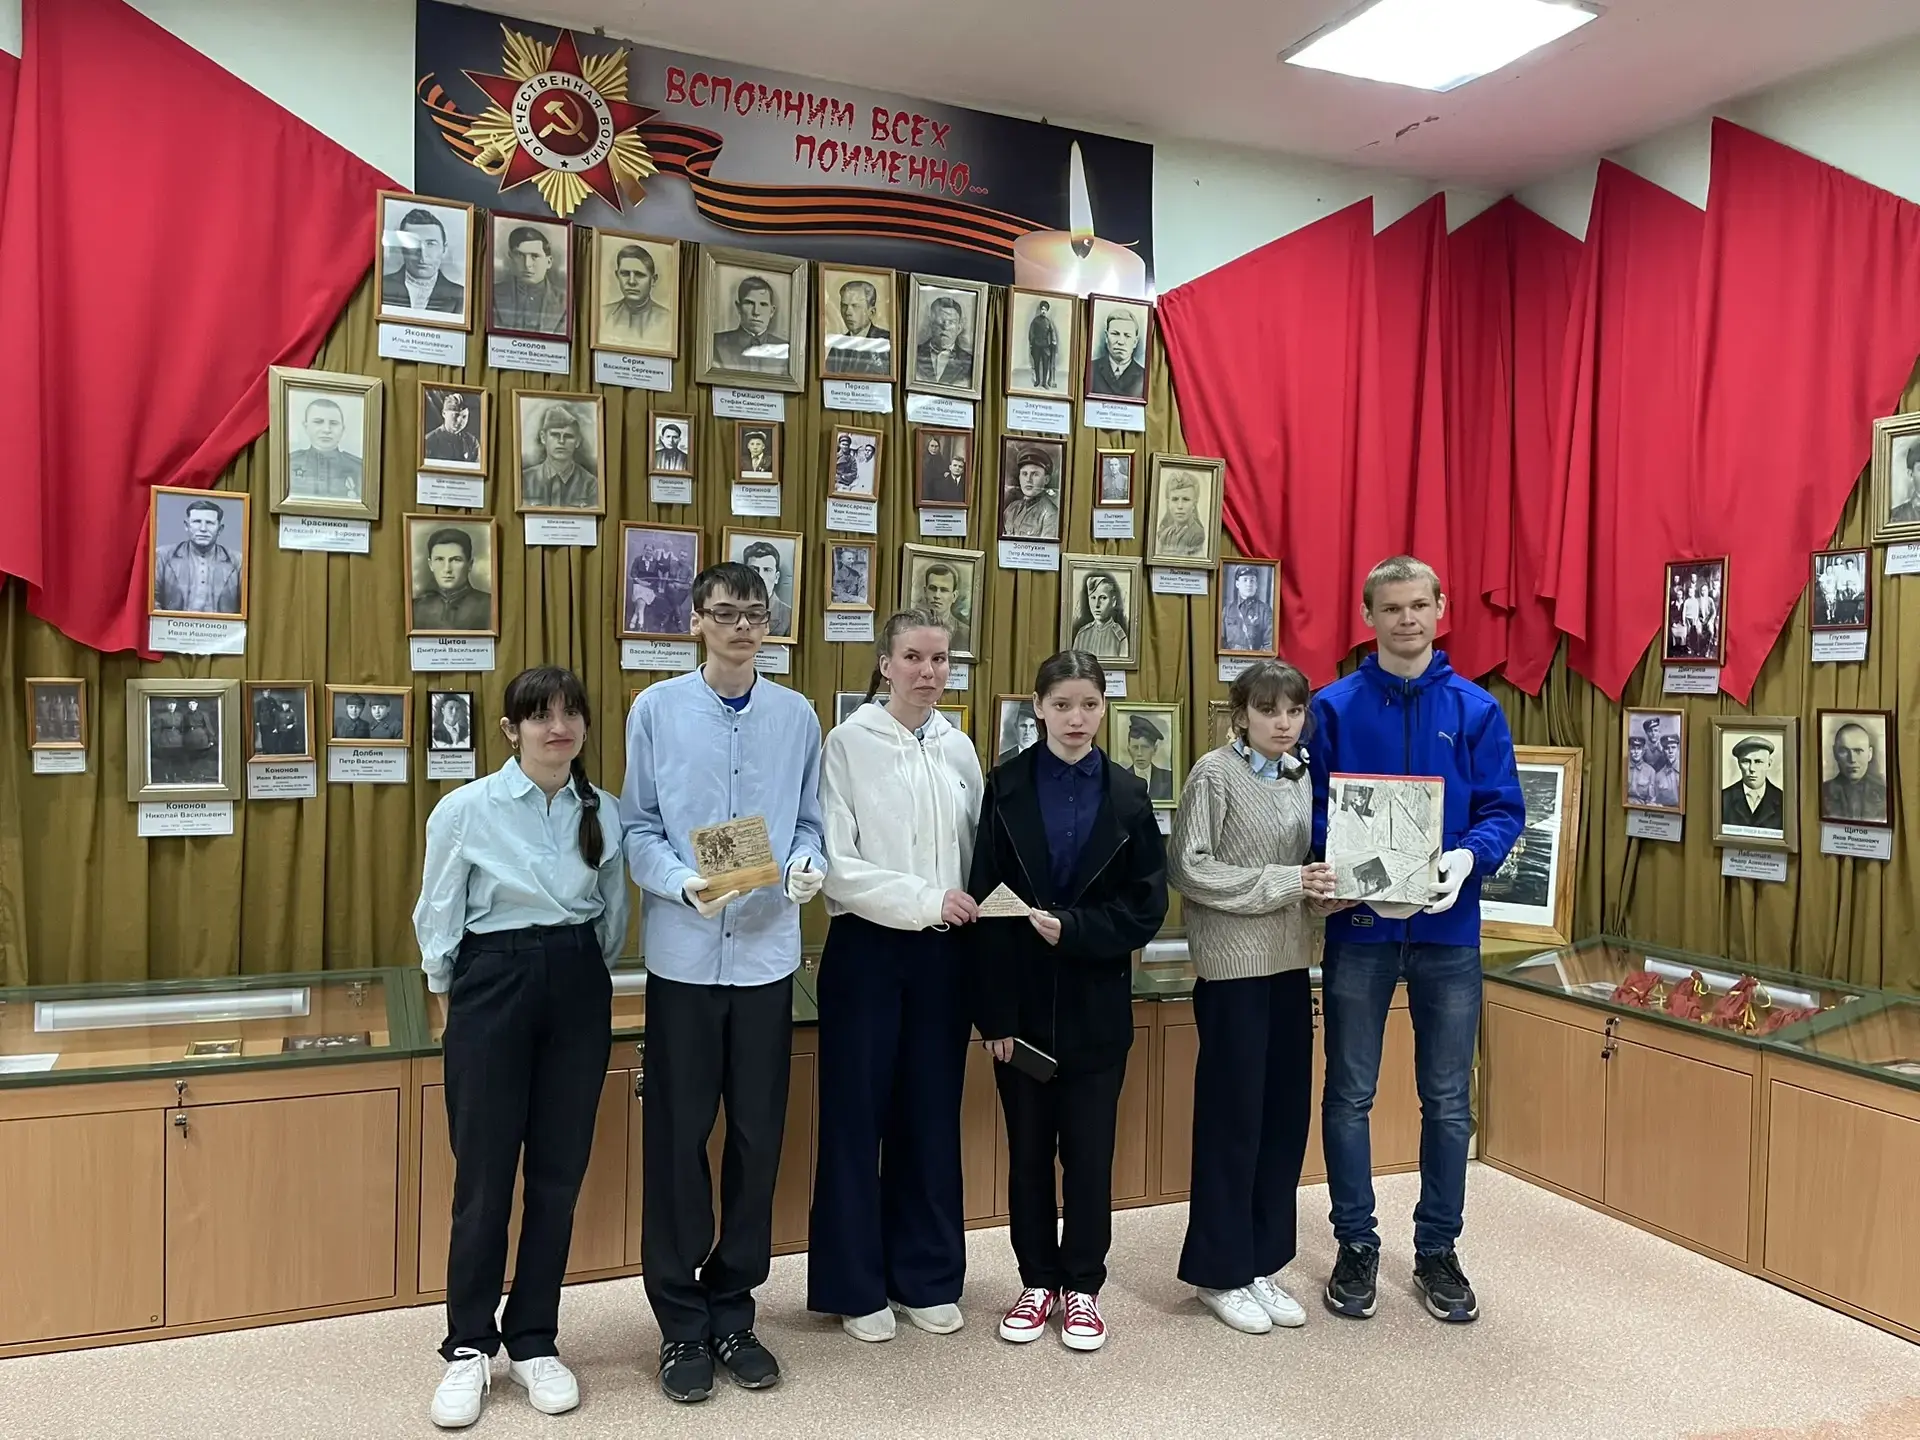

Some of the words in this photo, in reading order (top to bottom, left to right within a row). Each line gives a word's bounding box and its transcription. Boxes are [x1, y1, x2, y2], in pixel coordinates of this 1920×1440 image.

[666, 67, 855, 134] ВСПОМНИМ
[870, 106, 951, 150] ВСЕХ
[516, 75, 602, 156] ОТЕЧЕСТВЕННАЯ
[581, 117, 611, 166] ВОЙНА
[794, 134, 989, 197] ПОИМЕННО...
[404, 328, 441, 340] Яковлев
[511, 339, 546, 350] Соколов
[621, 356, 645, 365] Серик
[300, 518, 349, 528] Красников
[1013, 542, 1046, 551] Золотухин
[167, 619, 228, 630] Голоктионов
[189, 630, 227, 638] Иванович
[438, 637, 467, 646] Щитов
[352, 749, 384, 758] Долбня
[166, 802, 207, 810] Кононов
[145, 811, 179, 819] Николай
[179, 811, 227, 819] Васильевич
[1843, 826, 1868, 835] Щитов
